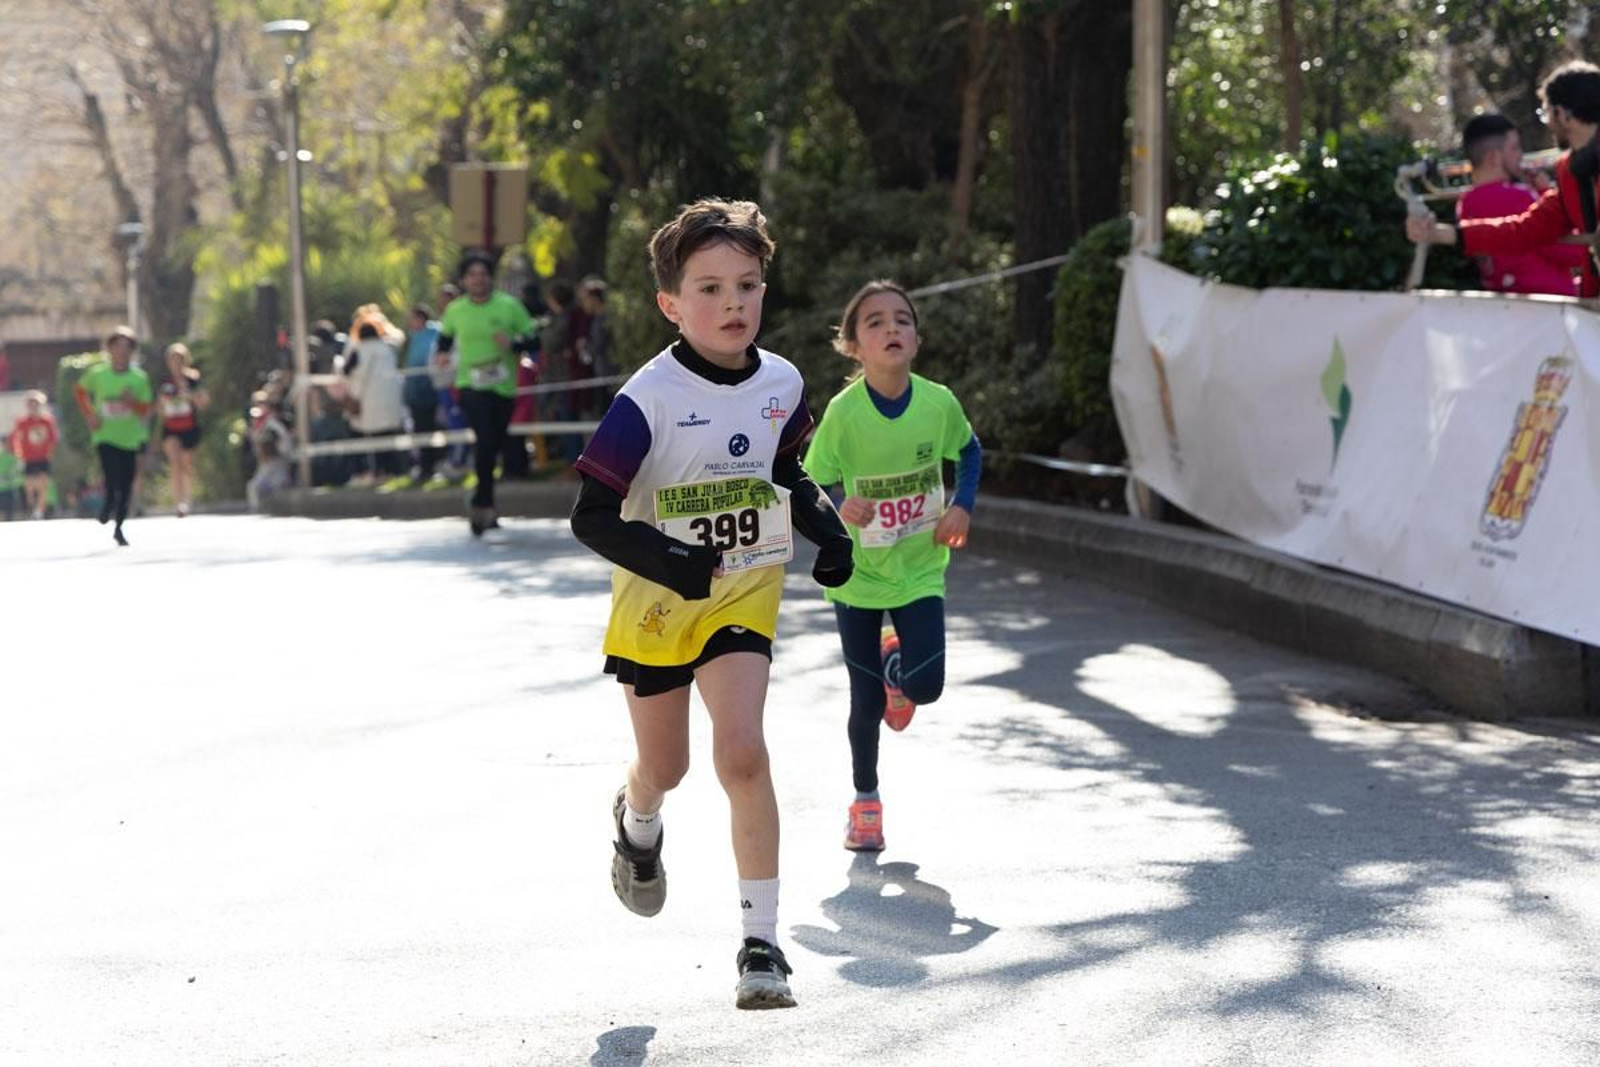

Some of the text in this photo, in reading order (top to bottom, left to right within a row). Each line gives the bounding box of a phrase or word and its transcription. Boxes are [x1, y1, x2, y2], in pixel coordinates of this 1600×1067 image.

[704, 460, 765, 470] PABLO CARVAJAL
[681, 485, 698, 499] SAN
[726, 478, 749, 493] BOSCO
[666, 490, 744, 513] IV CARRERA POPULAR
[879, 493, 926, 529] 982
[689, 508, 760, 552] 399
